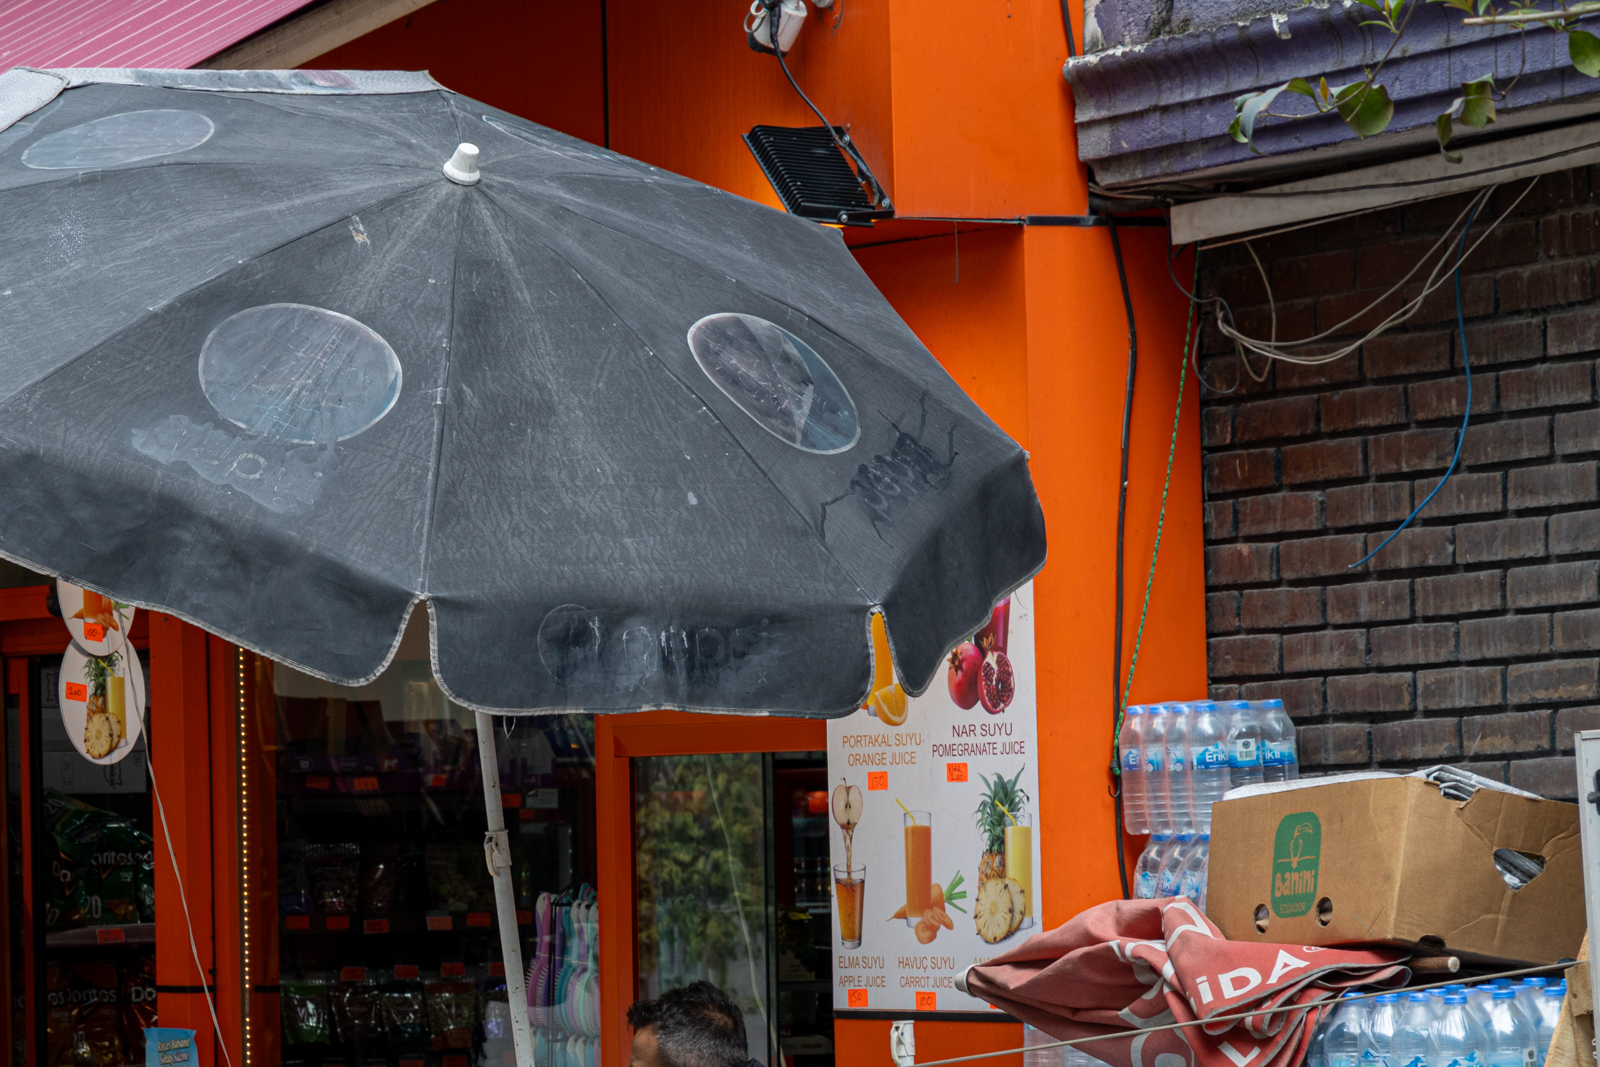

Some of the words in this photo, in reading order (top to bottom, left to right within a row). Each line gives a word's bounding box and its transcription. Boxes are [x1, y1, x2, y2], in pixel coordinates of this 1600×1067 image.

[952, 724, 977, 738] NAR
[979, 722, 1013, 737] SUYU
[842, 733, 892, 748] PORTAKAL
[894, 732, 922, 746] SUYU
[932, 743, 998, 758] POMEGRANATE
[999, 741, 1026, 755] JUICE
[847, 752, 887, 766] ORANGE
[889, 751, 917, 765] JUICE
[91, 850, 133, 866] oritos
[838, 956, 861, 969] ELMA
[861, 956, 885, 970] SUYU
[898, 956, 929, 973] HAVUÇ
[930, 956, 955, 970] SUYU
[838, 976, 863, 988] APPLE
[864, 976, 886, 988] JUICE
[900, 976, 930, 988] CARROT
[932, 976, 953, 988] JUICE
